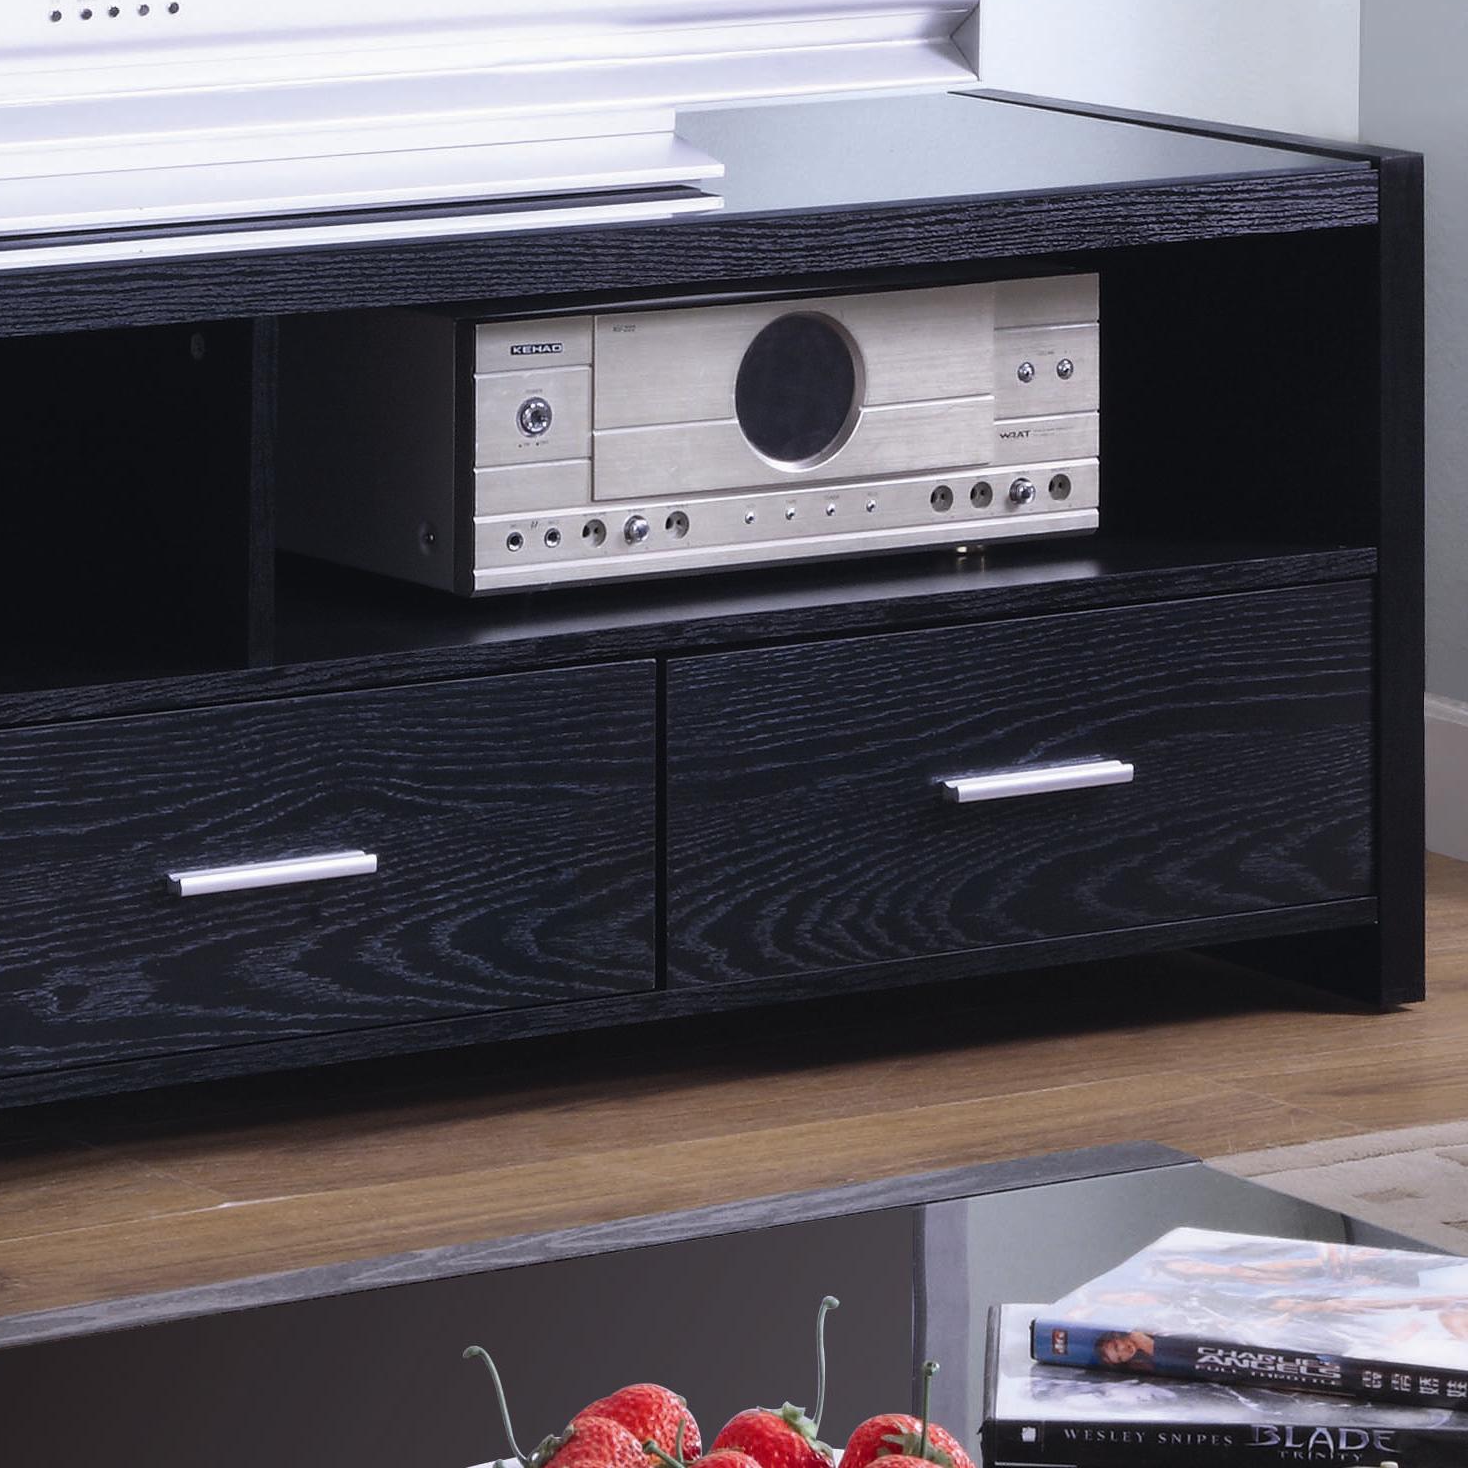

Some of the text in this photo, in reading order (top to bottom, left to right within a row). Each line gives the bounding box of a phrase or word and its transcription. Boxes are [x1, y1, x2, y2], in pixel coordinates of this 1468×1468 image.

[1196, 1355, 1341, 1379] ANGELS
[1064, 1429, 1233, 1446] WESLEY SNIPES
[1243, 1424, 1401, 1454] BLADE
[1279, 1451, 1363, 1462] TRINITY
